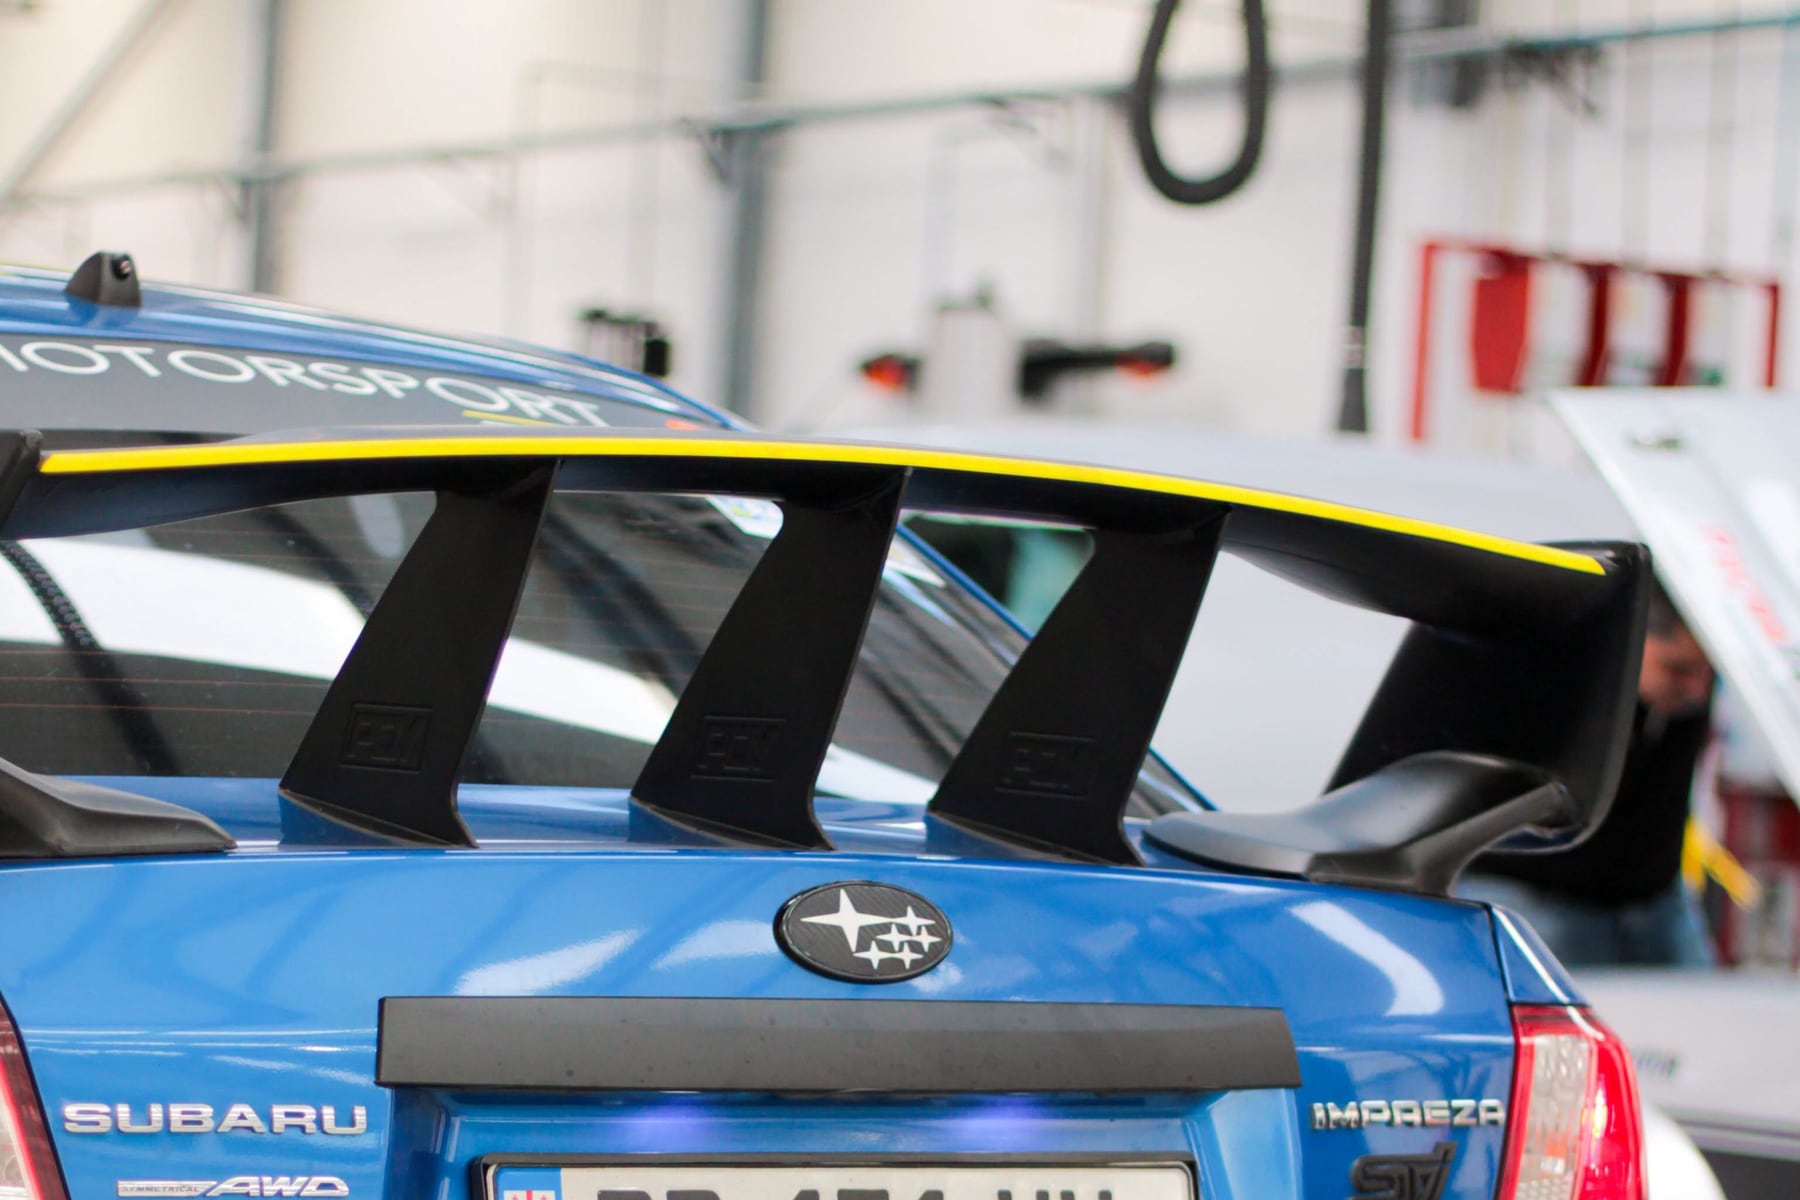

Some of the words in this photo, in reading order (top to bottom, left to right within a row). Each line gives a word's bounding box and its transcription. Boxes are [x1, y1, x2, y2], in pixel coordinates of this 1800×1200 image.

[63, 1102, 367, 1135] SUBARU
[1311, 1098, 1506, 1131] IMPREZA
[121, 1185, 201, 1194] SYMMETRICAL
[205, 1175, 350, 1198] AWD
